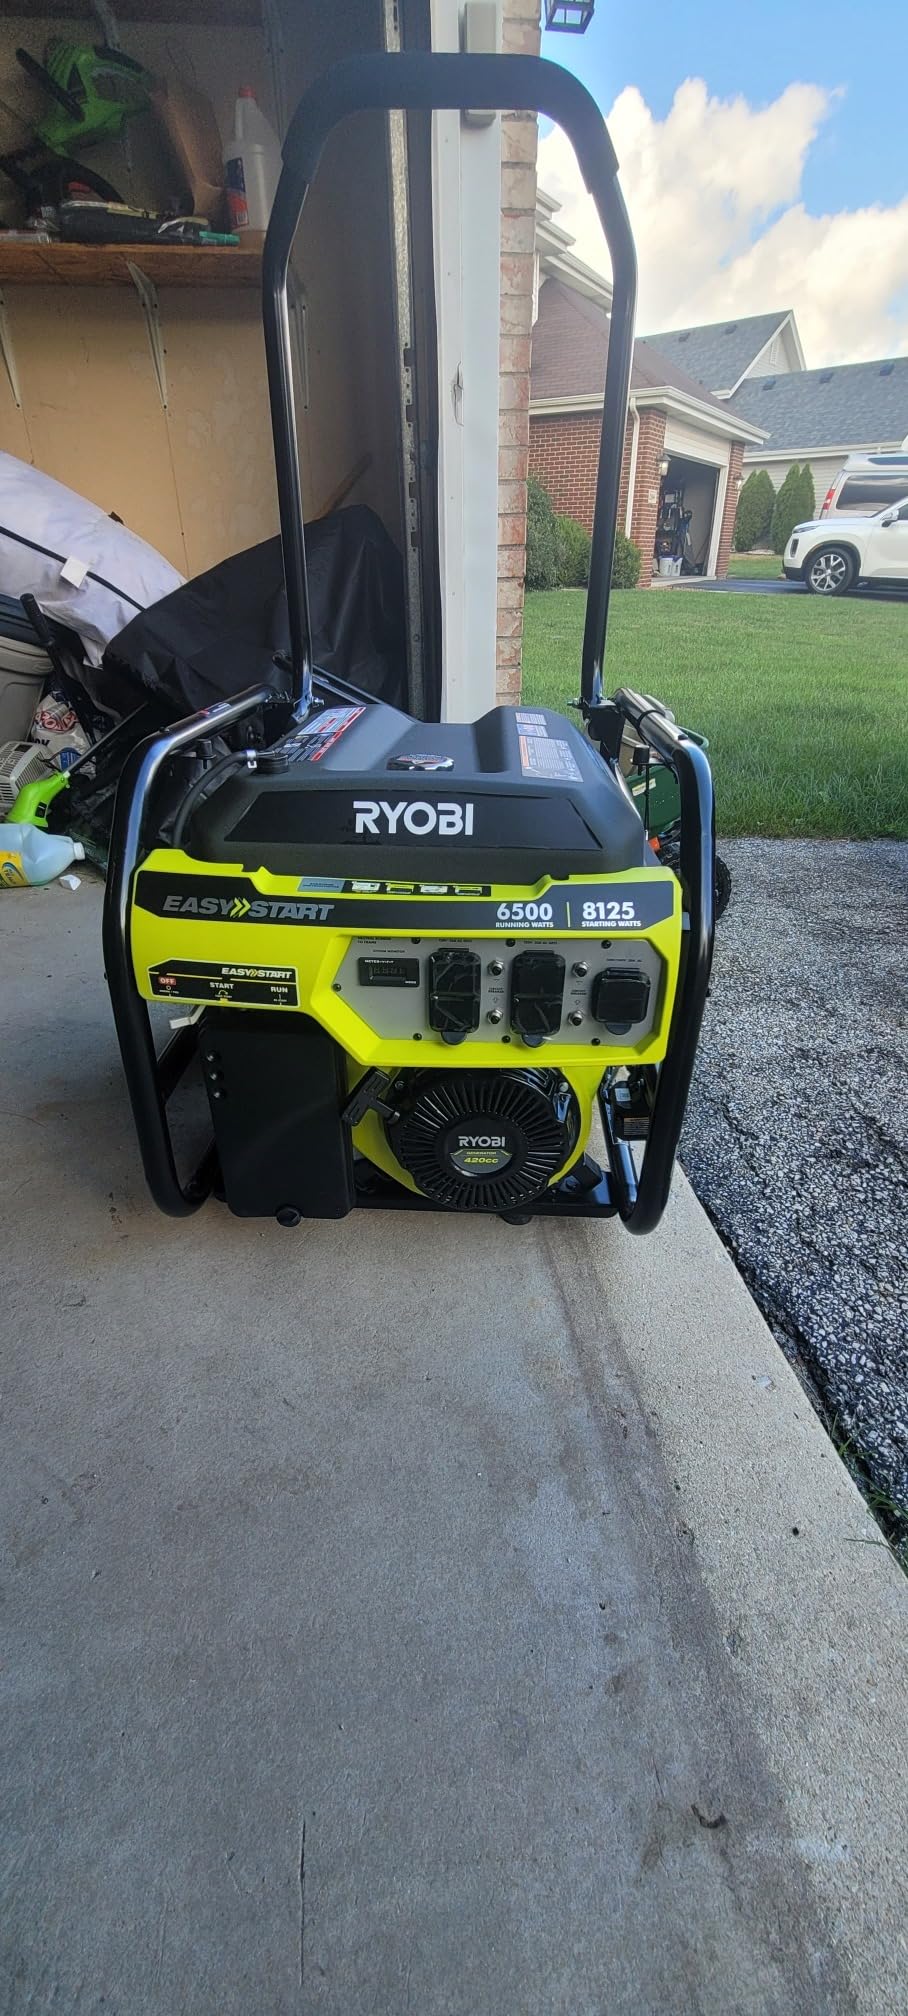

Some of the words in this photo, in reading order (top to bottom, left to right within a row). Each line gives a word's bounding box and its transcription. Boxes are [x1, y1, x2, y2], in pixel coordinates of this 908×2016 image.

[353, 800, 474, 836] RYOBI
[162, 895, 235, 915] EASY
[247, 900, 335, 921] START
[496, 902, 553, 921] 6500
[582, 901, 635, 920] 8125
[581, 920, 617, 928] STARTING
[221, 967, 252, 976] EASY
[256, 970, 293, 979] START
[160, 977, 175, 985] OFF
[209, 981, 234, 990] START
[458, 1135, 506, 1147] RYOBI
